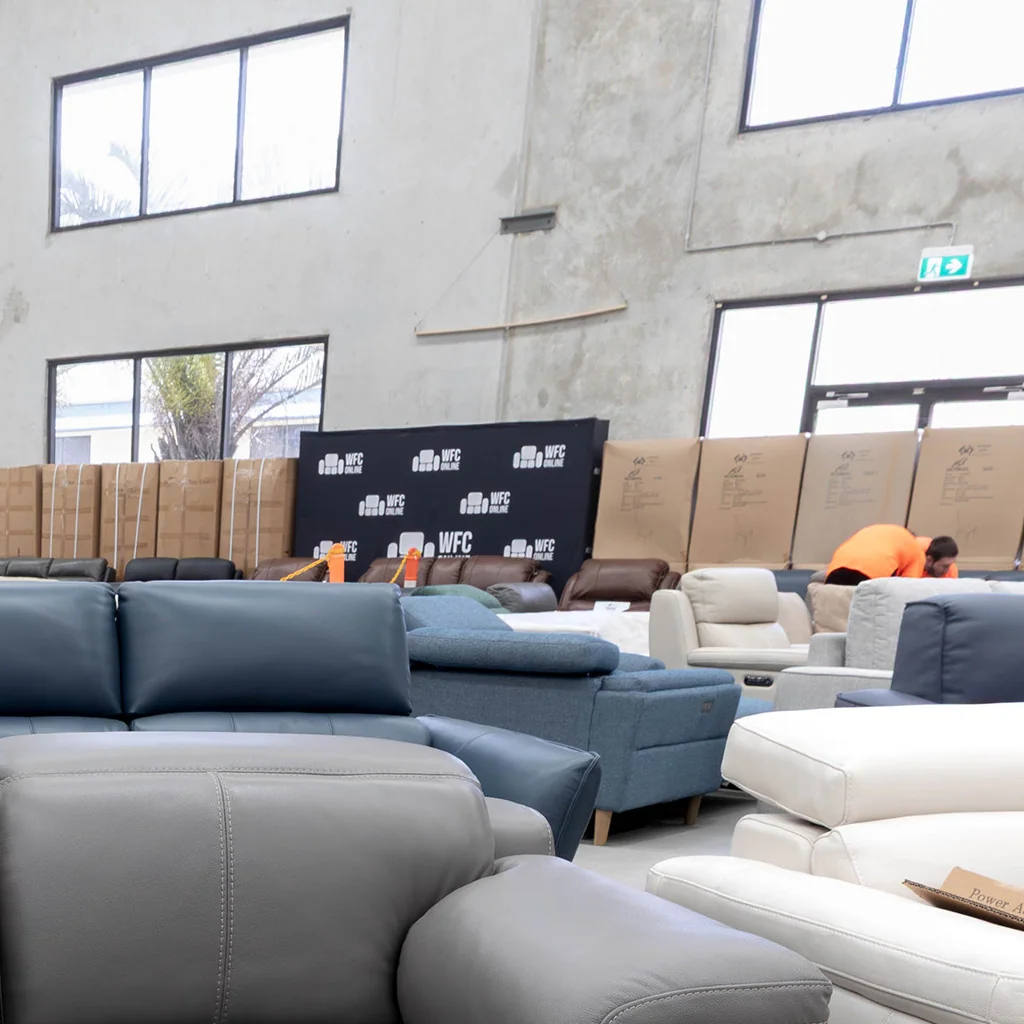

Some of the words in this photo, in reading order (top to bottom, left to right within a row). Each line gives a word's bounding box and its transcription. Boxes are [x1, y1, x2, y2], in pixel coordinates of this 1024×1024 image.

[441, 448, 461, 462] WFC
[545, 444, 566, 458] WFC
[345, 452, 364, 466] WFC
[440, 461, 460, 471] ONLINE
[543, 458, 564, 468] ONLINE
[344, 465, 363, 474] ONLINE
[386, 493, 406, 507] WFC
[490, 491, 511, 505] WFC
[385, 507, 404, 516] ONLINE
[488, 504, 509, 514] ONLINE
[439, 530, 473, 554] WFC
[534, 538, 556, 552] WFC
[968, 887, 1010, 909] Power
